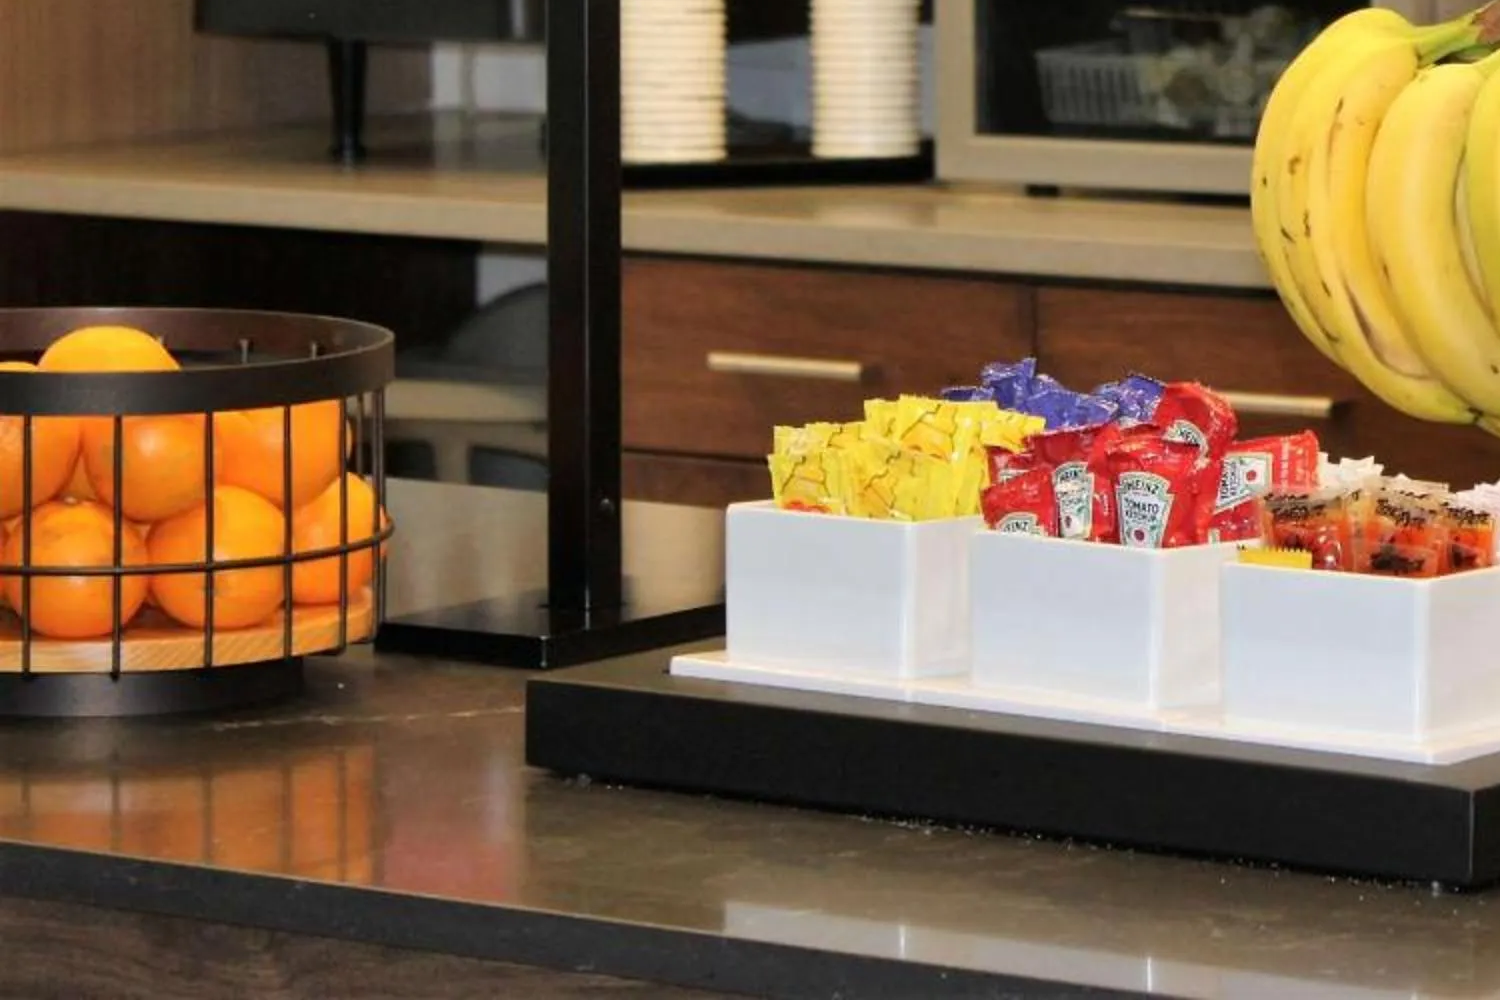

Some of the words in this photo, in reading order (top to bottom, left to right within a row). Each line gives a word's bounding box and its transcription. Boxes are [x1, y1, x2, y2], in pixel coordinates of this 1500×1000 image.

[1123, 479, 1160, 495] HEINZ
[1123, 497, 1160, 515] TOMATO
[1001, 521, 1029, 533] EINZ
